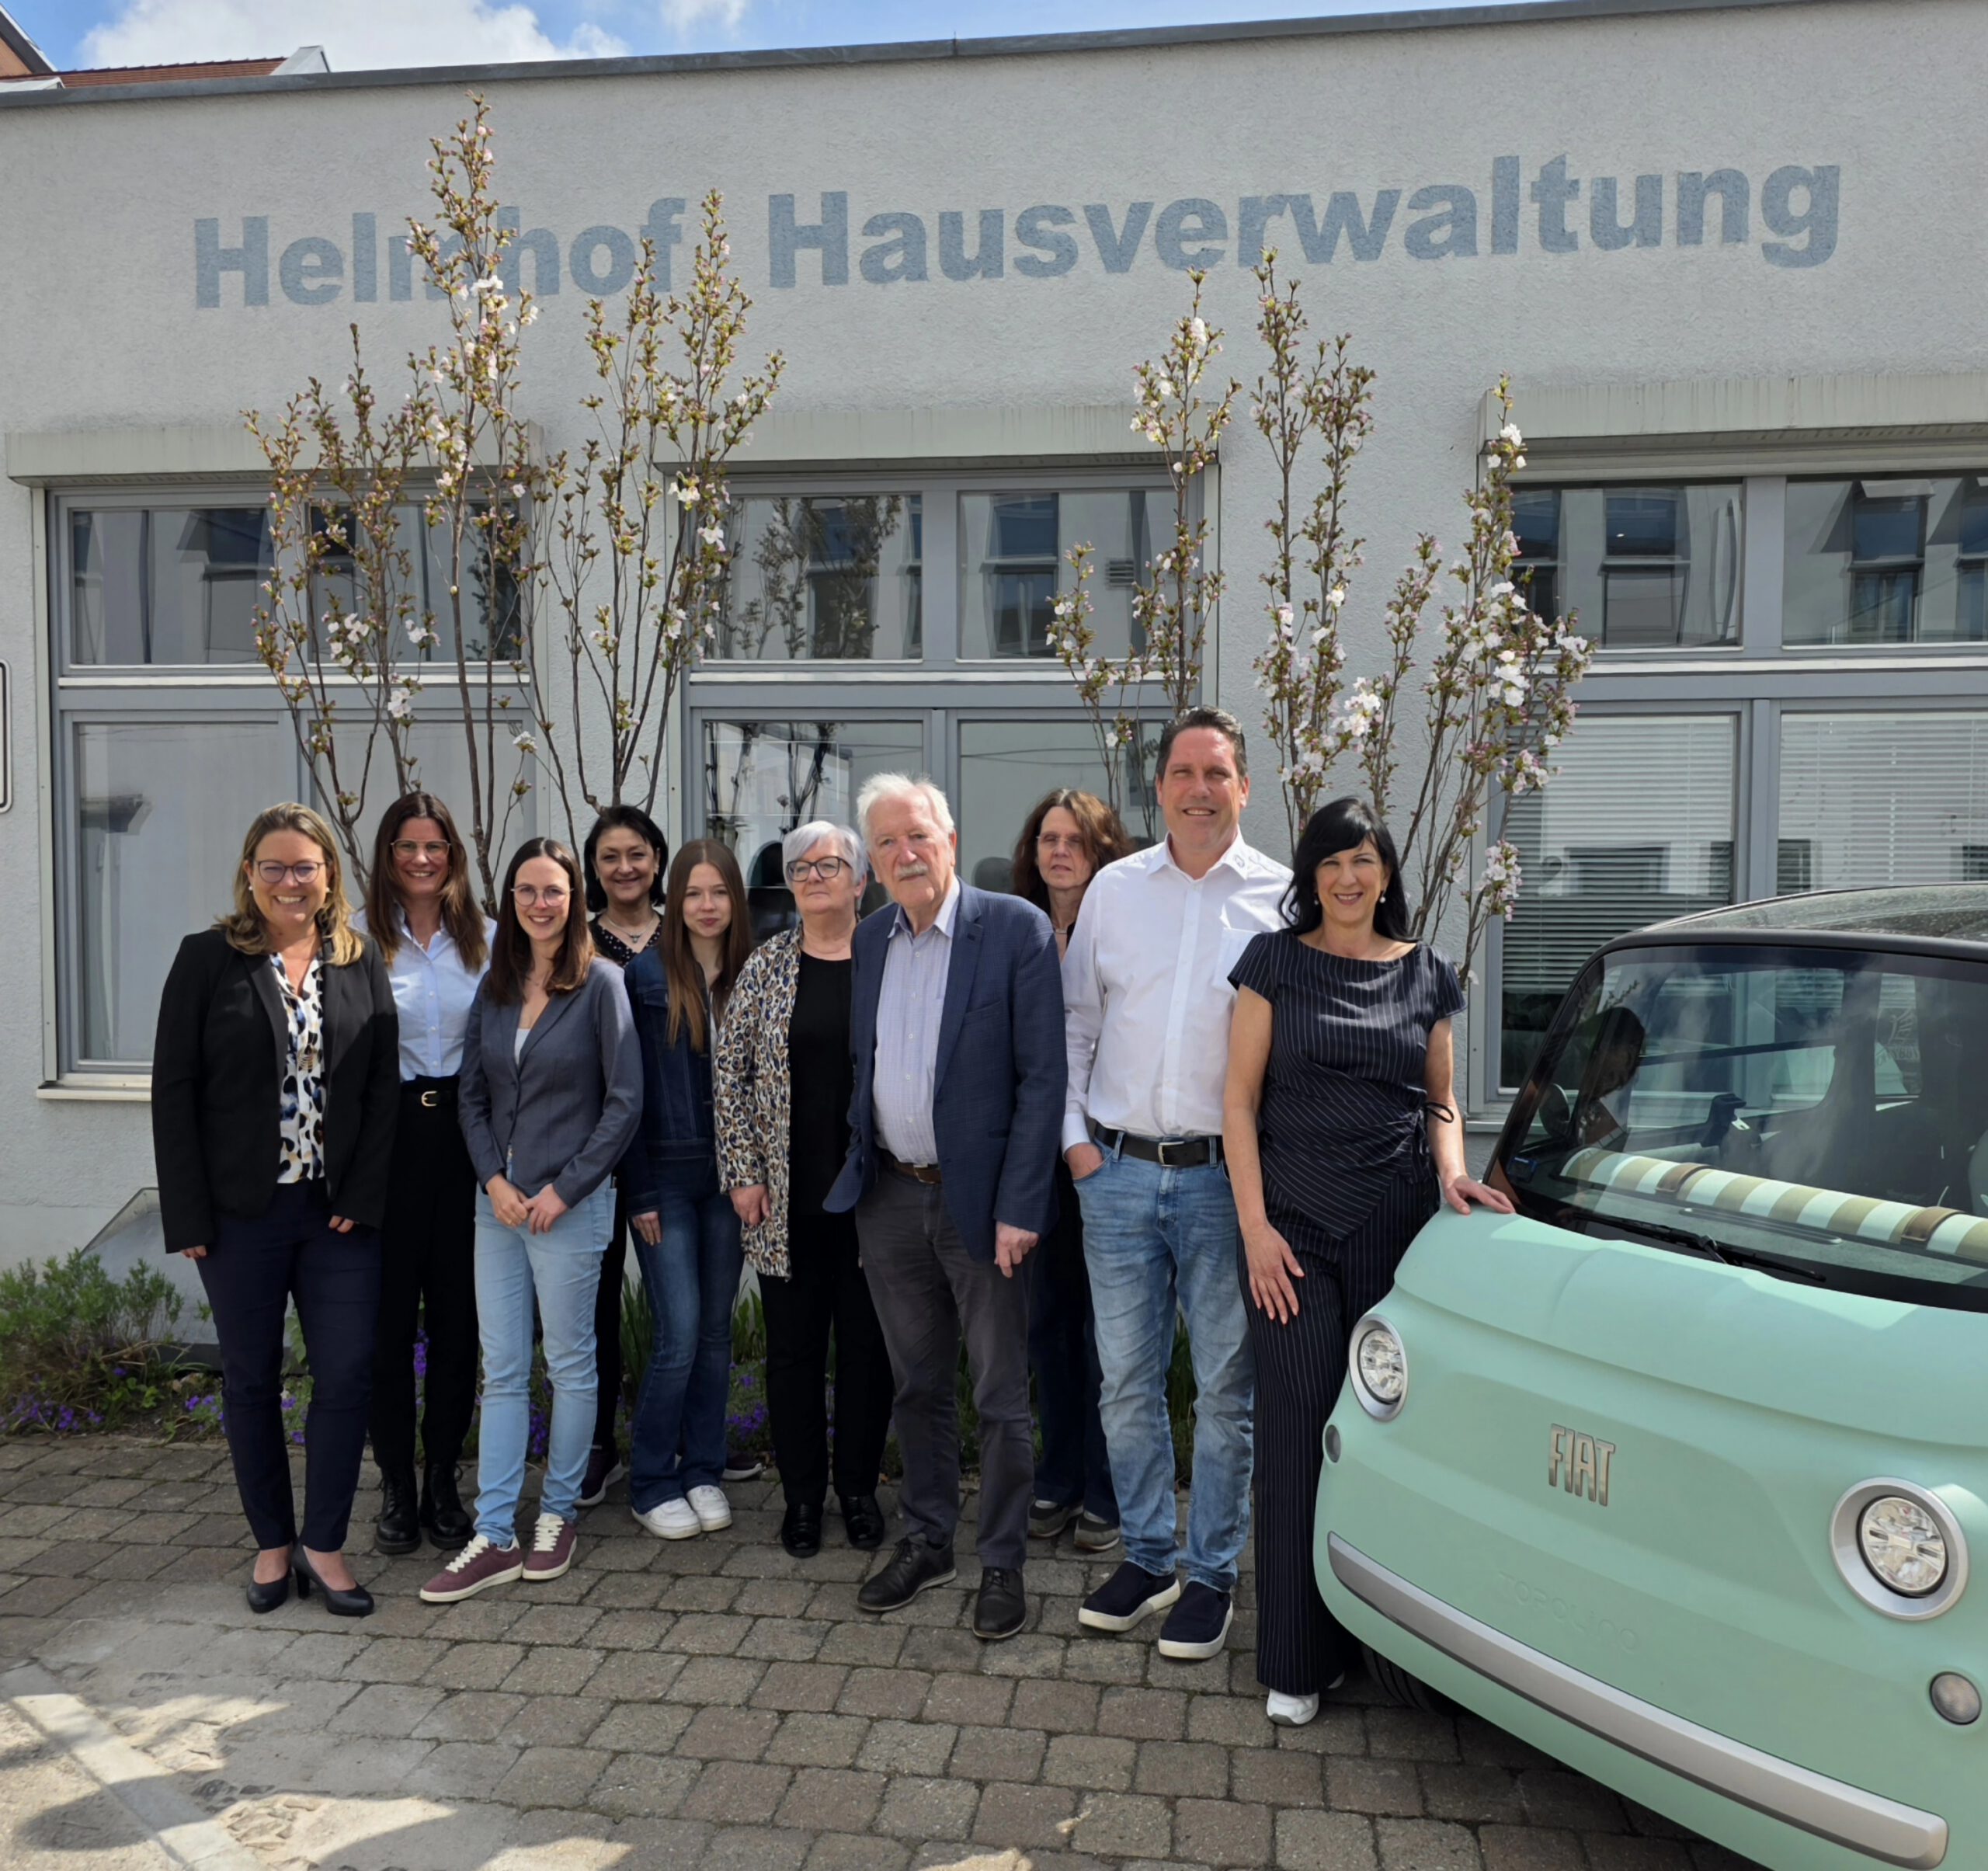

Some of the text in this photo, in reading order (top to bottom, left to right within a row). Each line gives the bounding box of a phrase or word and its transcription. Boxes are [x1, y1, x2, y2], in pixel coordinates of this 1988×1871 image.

[194, 155, 1841, 308] Helmhof Hausverwaltung
[1548, 1423, 1615, 1507] FIAT
